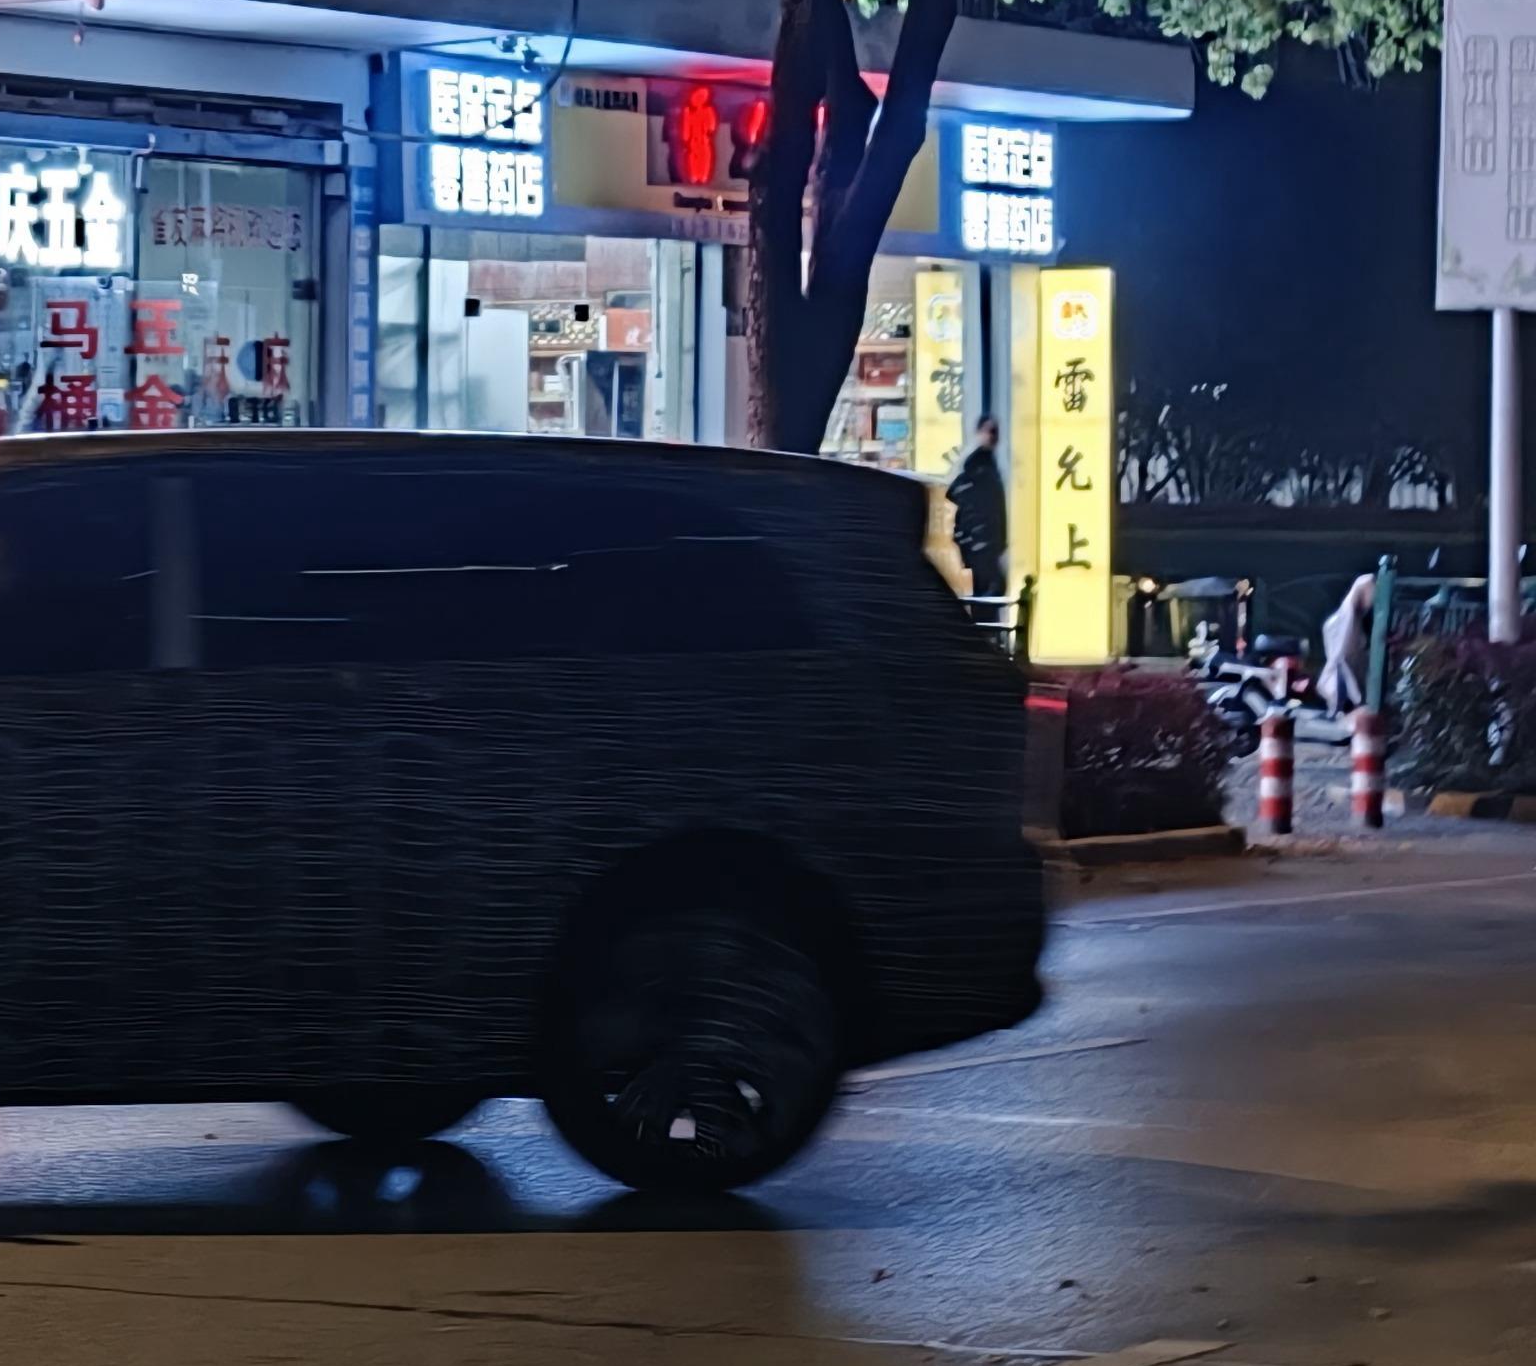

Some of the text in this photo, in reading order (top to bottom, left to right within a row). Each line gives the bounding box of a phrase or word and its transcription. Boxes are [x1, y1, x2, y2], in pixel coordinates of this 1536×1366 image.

[428, 68, 543, 145] 医保定点
[430, 143, 544, 218] 零售药店
[961, 123, 1054, 188] 医保定点
[961, 189, 1054, 255] 零售药店
[1054, 356, 1096, 571] 雷允上
